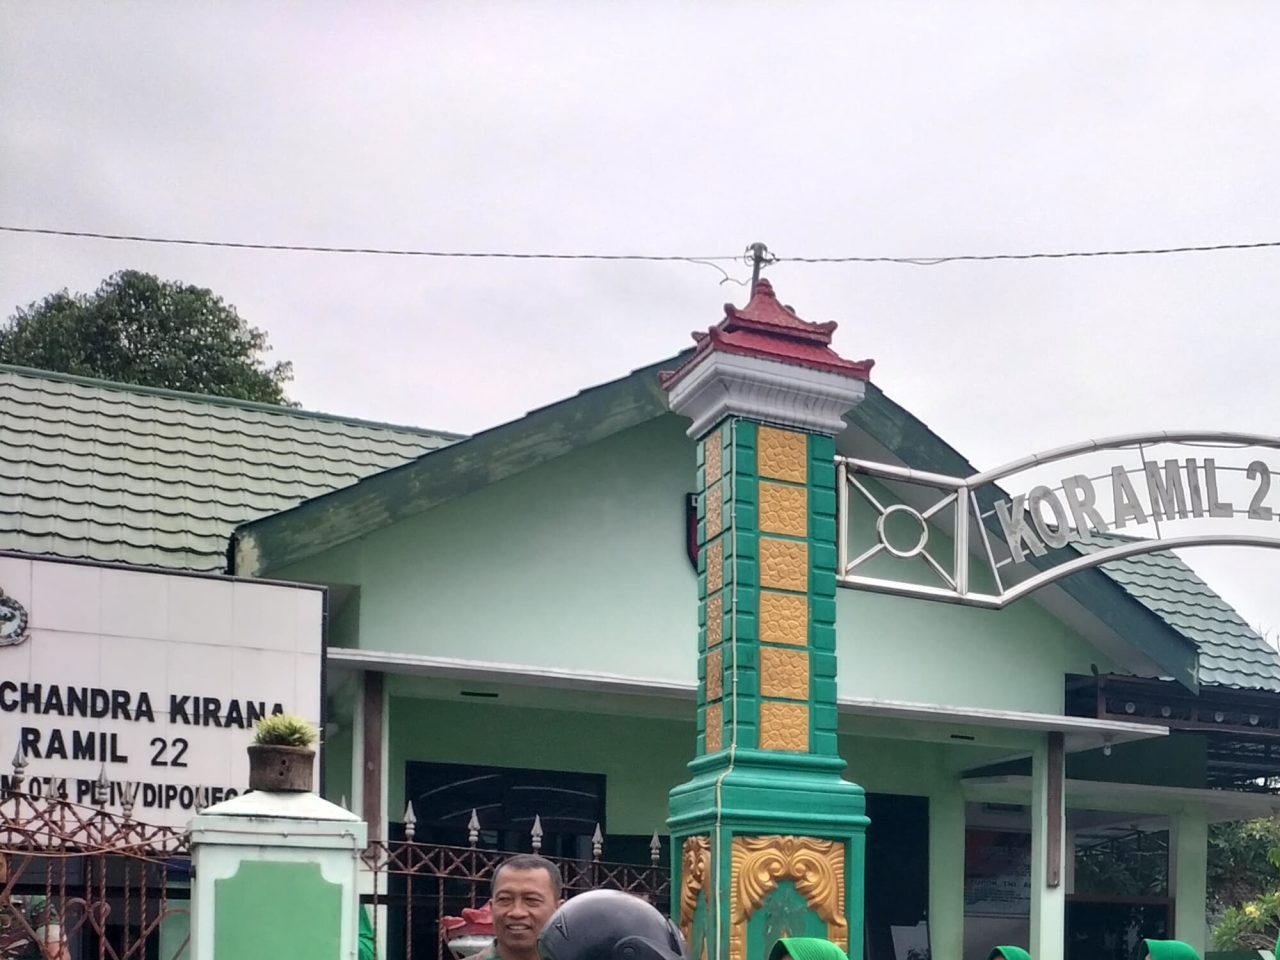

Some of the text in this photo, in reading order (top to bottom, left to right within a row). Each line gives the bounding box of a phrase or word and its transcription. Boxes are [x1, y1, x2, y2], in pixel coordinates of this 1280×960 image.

[993, 458, 1233, 564] KORAMIL
[0, 680, 154, 723] CHANDRA
[149, 737, 189, 768] 22
